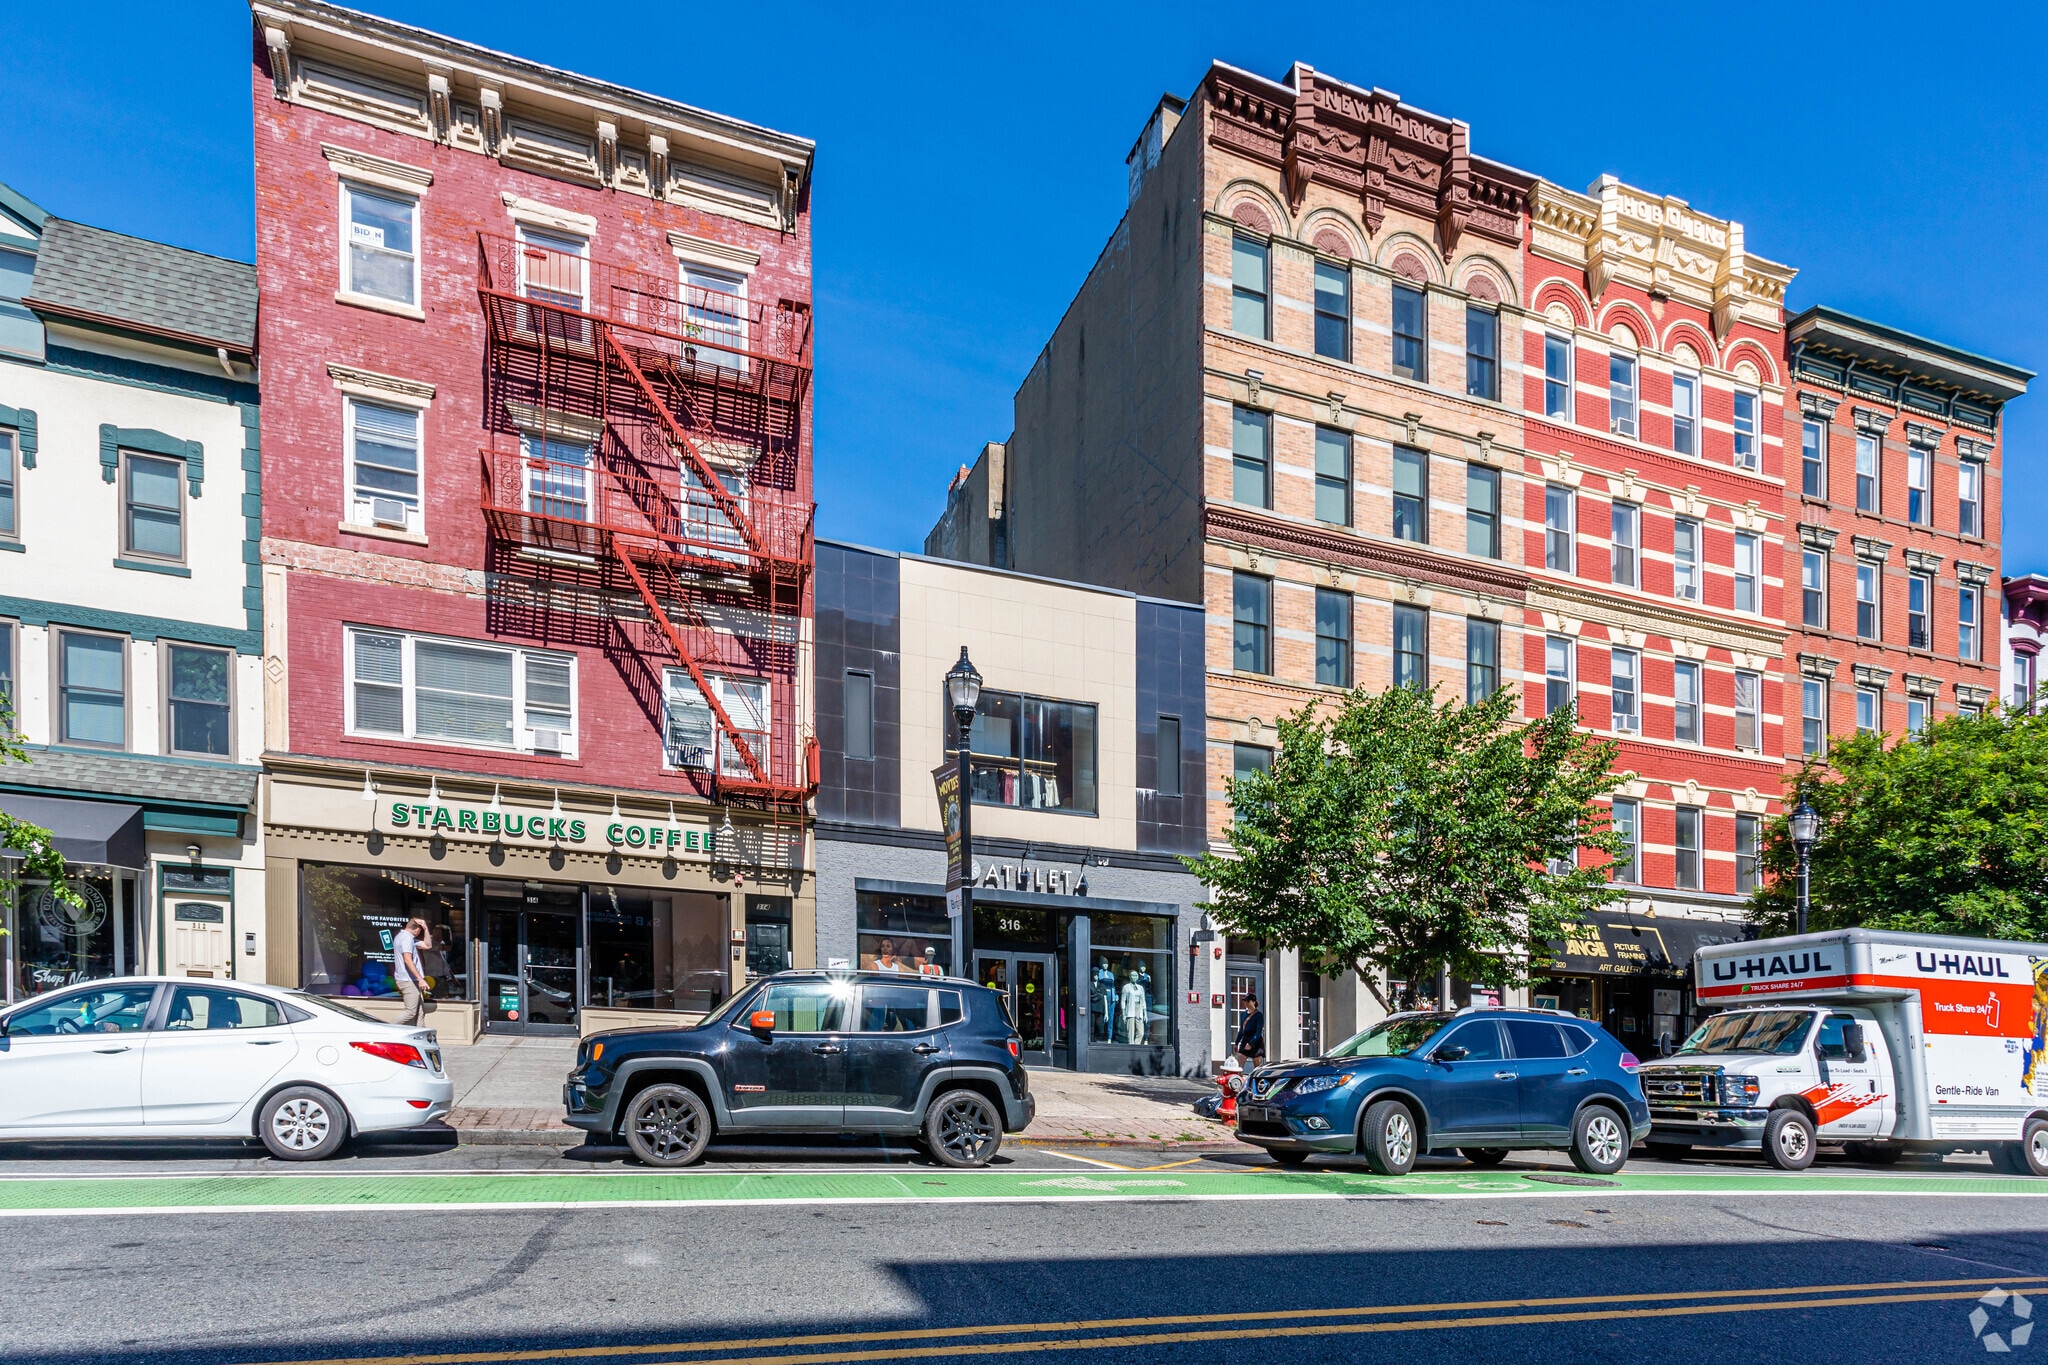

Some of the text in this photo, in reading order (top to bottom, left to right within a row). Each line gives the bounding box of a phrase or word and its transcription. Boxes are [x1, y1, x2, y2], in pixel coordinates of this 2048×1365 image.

[1325, 87, 1435, 144] NEW YORK
[1623, 194, 1720, 243] HOBOKEN
[354, 226, 382, 239] BIDN
[391, 802, 717, 851] STARBUCKS COFFEE
[985, 863, 1090, 890] ATHLETA
[1000, 918, 1020, 931] 316
[1566, 940, 1609, 958] ANGLE
[1613, 943, 1641, 952] PICTURE
[1617, 952, 1646, 960] FRAMING
[1555, 961, 1567, 969] 320
[1599, 964, 1612, 972] ART
[1614, 965, 1643, 973] GALLERY
[1713, 952, 1832, 981] U-HAUL
[1916, 951, 2010, 978] U-HAUL
[33, 969, 65, 987] Shop
[1770, 982, 1790, 990] SHARE
[1934, 1002, 1993, 1015] Truck Share 24/7
[1935, 1084, 1999, 1096] Gentle-Ride Van
